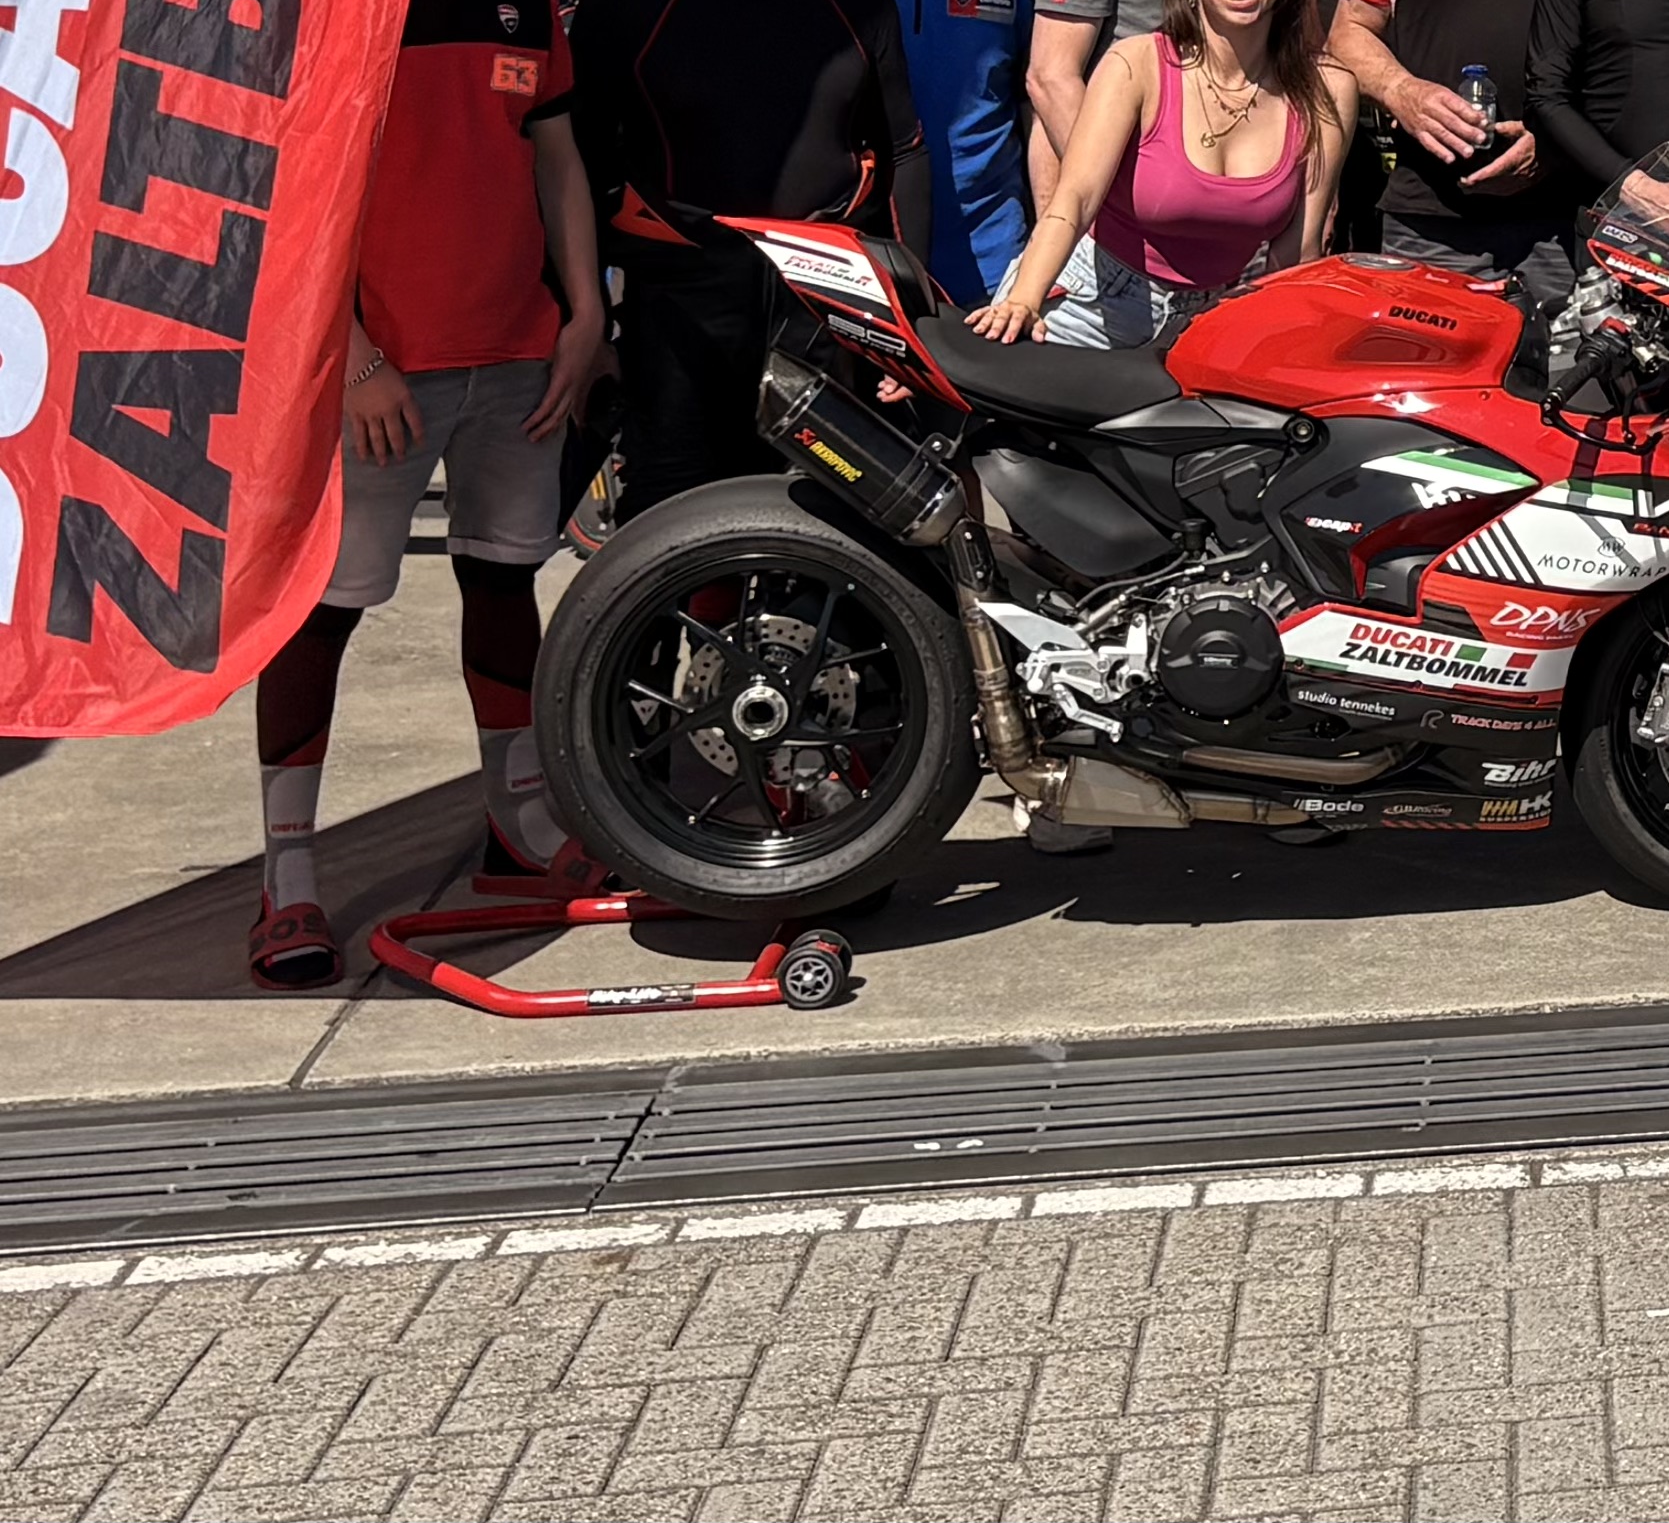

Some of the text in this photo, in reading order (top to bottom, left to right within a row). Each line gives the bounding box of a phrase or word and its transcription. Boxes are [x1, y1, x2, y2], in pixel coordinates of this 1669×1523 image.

[490, 54, 538, 96] 63
[1388, 305, 1457, 331] DUCATI
[1538, 554, 1667, 578] MOTORWRAP
[1490, 601, 1600, 632] DPNS
[1349, 624, 1456, 659] DUCATI
[1338, 641, 1531, 687] ZALTBOMMEL
[1298, 689, 1395, 716] studio tennekes
[1481, 759, 1557, 783] Bihr
